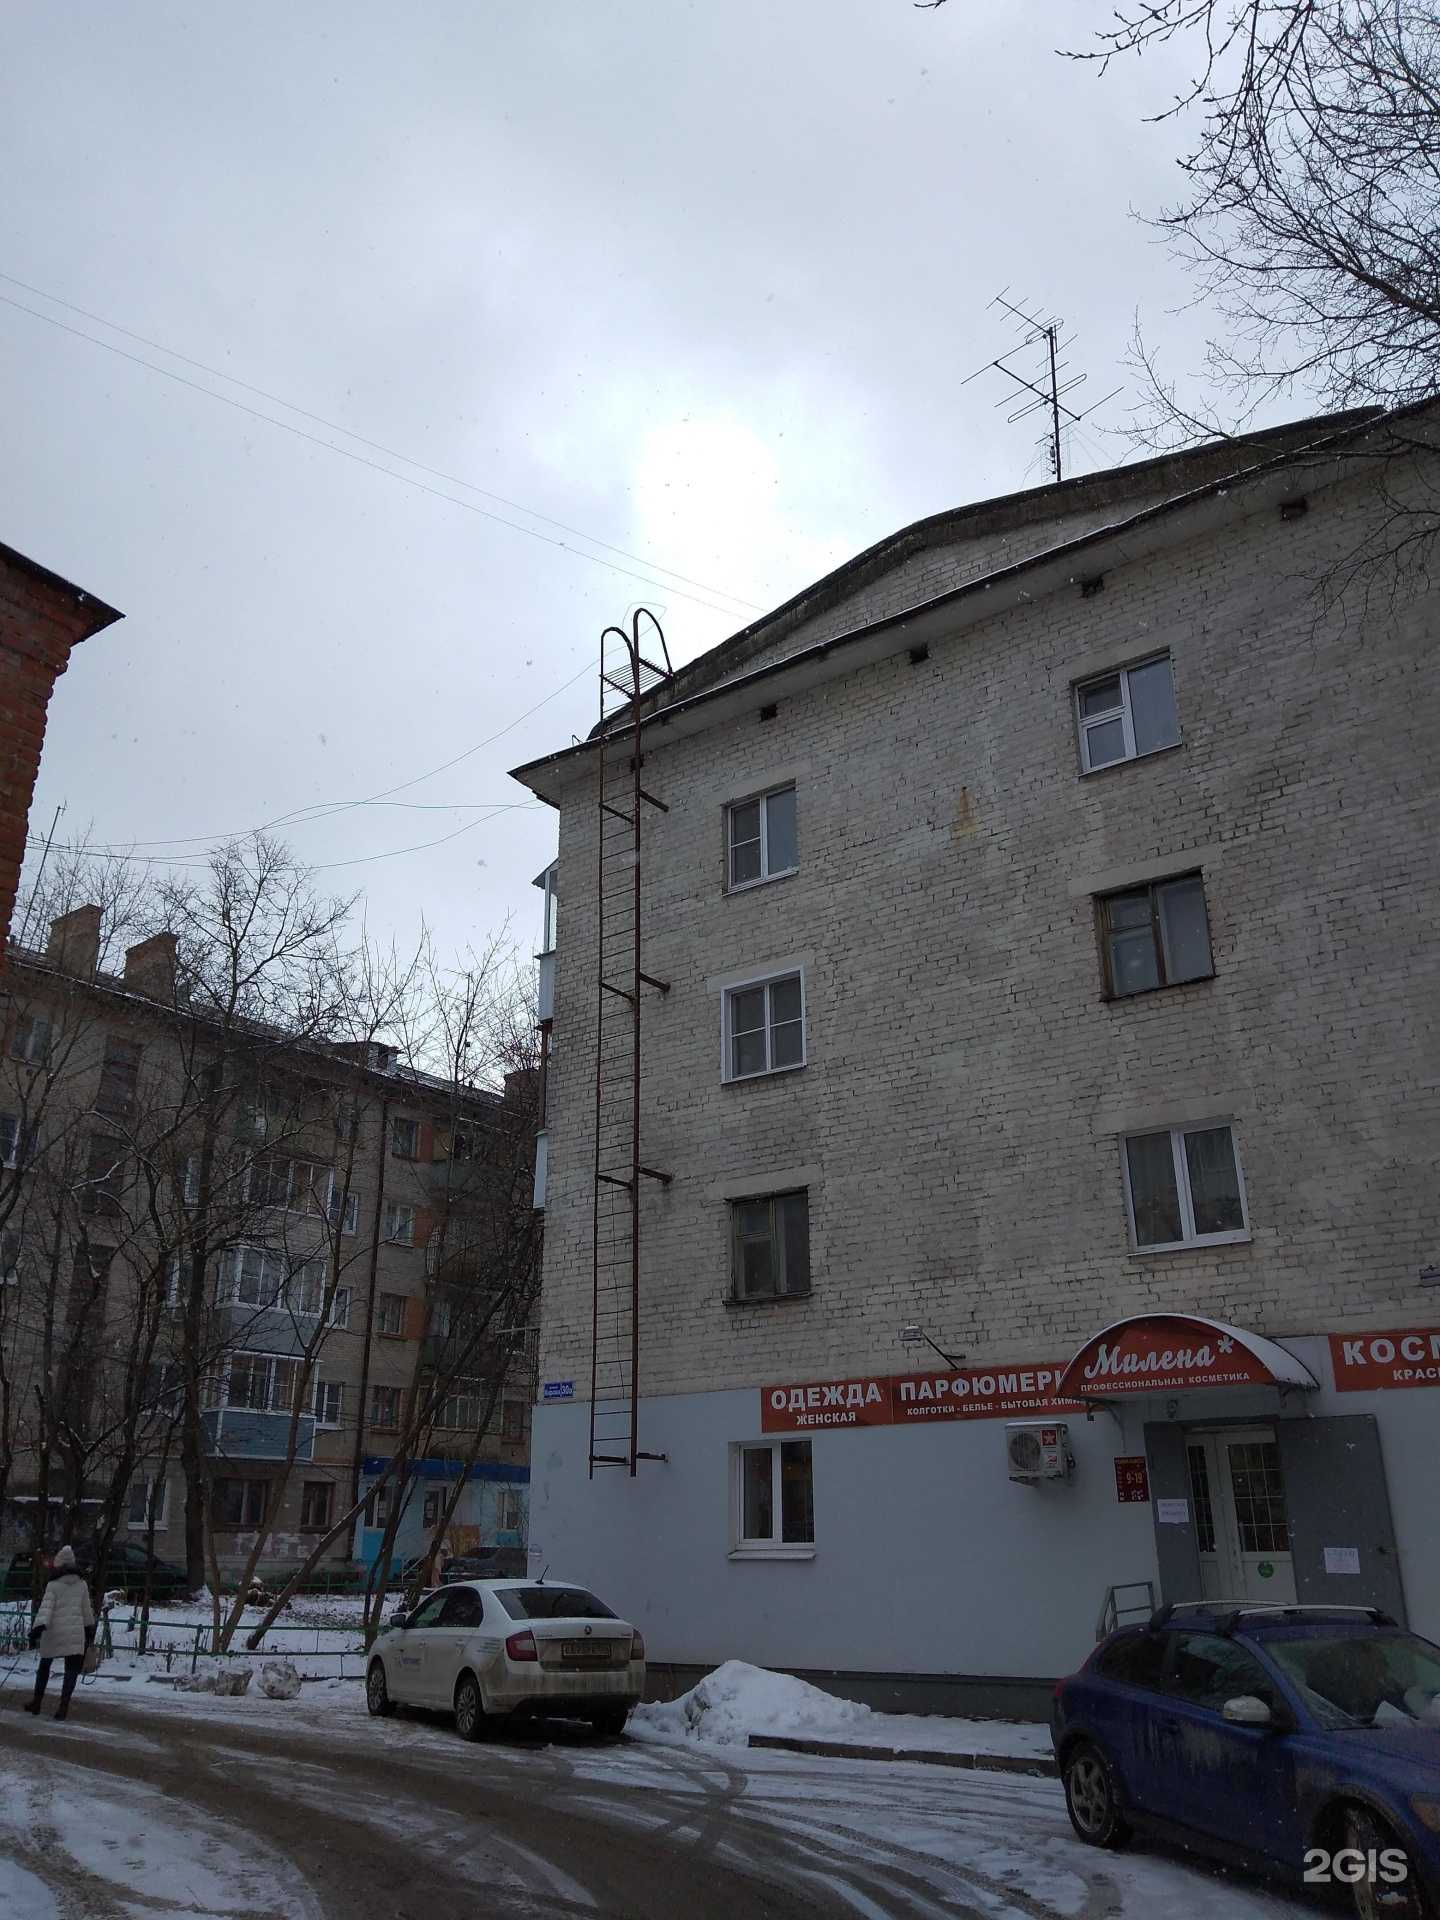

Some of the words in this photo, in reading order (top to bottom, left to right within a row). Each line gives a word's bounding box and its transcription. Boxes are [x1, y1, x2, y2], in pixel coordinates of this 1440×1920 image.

[1084, 1343, 1215, 1379] Милена
[1080, 1377, 1184, 1392] ПРОФЕССИОНАЛЬНАЯ
[1188, 1372, 1250, 1385] КОСМЕТИКА
[1393, 1367, 1440, 1381] КРАС
[771, 1382, 882, 1412] ОДЕЖДА
[907, 1405, 955, 1416] КОЛГОТКИ
[963, 1402, 993, 1412] БЕЛЬЕ
[1001, 1398, 1048, 1409] БЫТОВАЯ
[796, 1411, 856, 1425] ЖЕНСКАЯ
